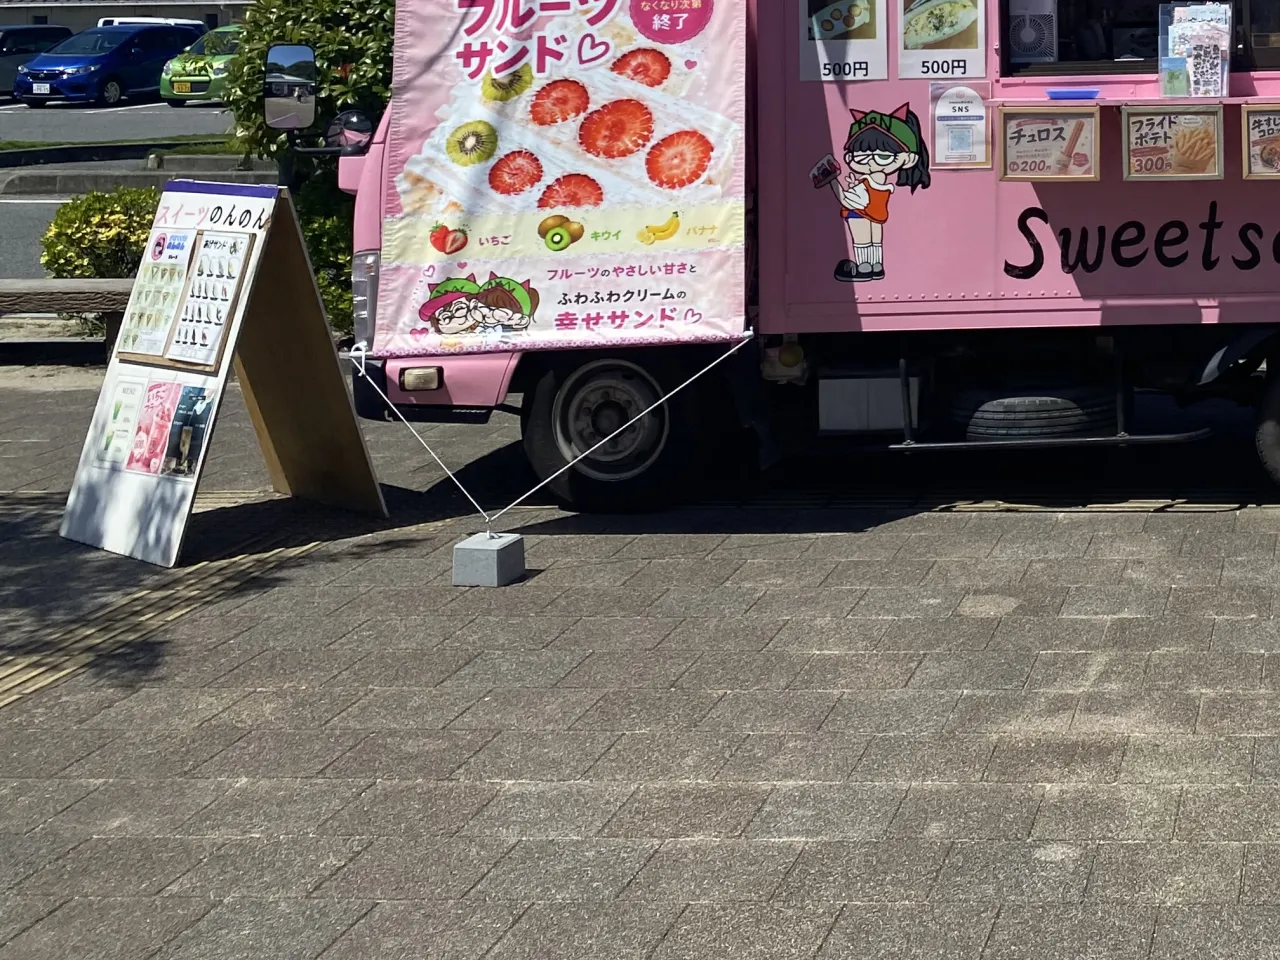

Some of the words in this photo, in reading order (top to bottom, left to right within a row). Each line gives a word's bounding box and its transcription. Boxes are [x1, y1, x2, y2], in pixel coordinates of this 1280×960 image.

[652, 14, 687, 31] 終了
[456, 34, 566, 78] サンド
[822, 61, 869, 77] 500円
[921, 60, 967, 75] 500円
[1131, 116, 1178, 132] フライド
[1251, 117, 1280, 130] 牛すじ
[1009, 127, 1066, 146] チュロス
[1135, 131, 1172, 146] ポテト
[1134, 157, 1172, 172] 300円
[590, 229, 621, 241] キウイ
[686, 225, 718, 236] バナナ
[479, 235, 511, 246] いちご
[547, 263, 696, 281] フルーツのやさしい甘さと
[557, 288, 686, 306] ふわふわクリームの
[554, 307, 678, 331] 幸せサンド
